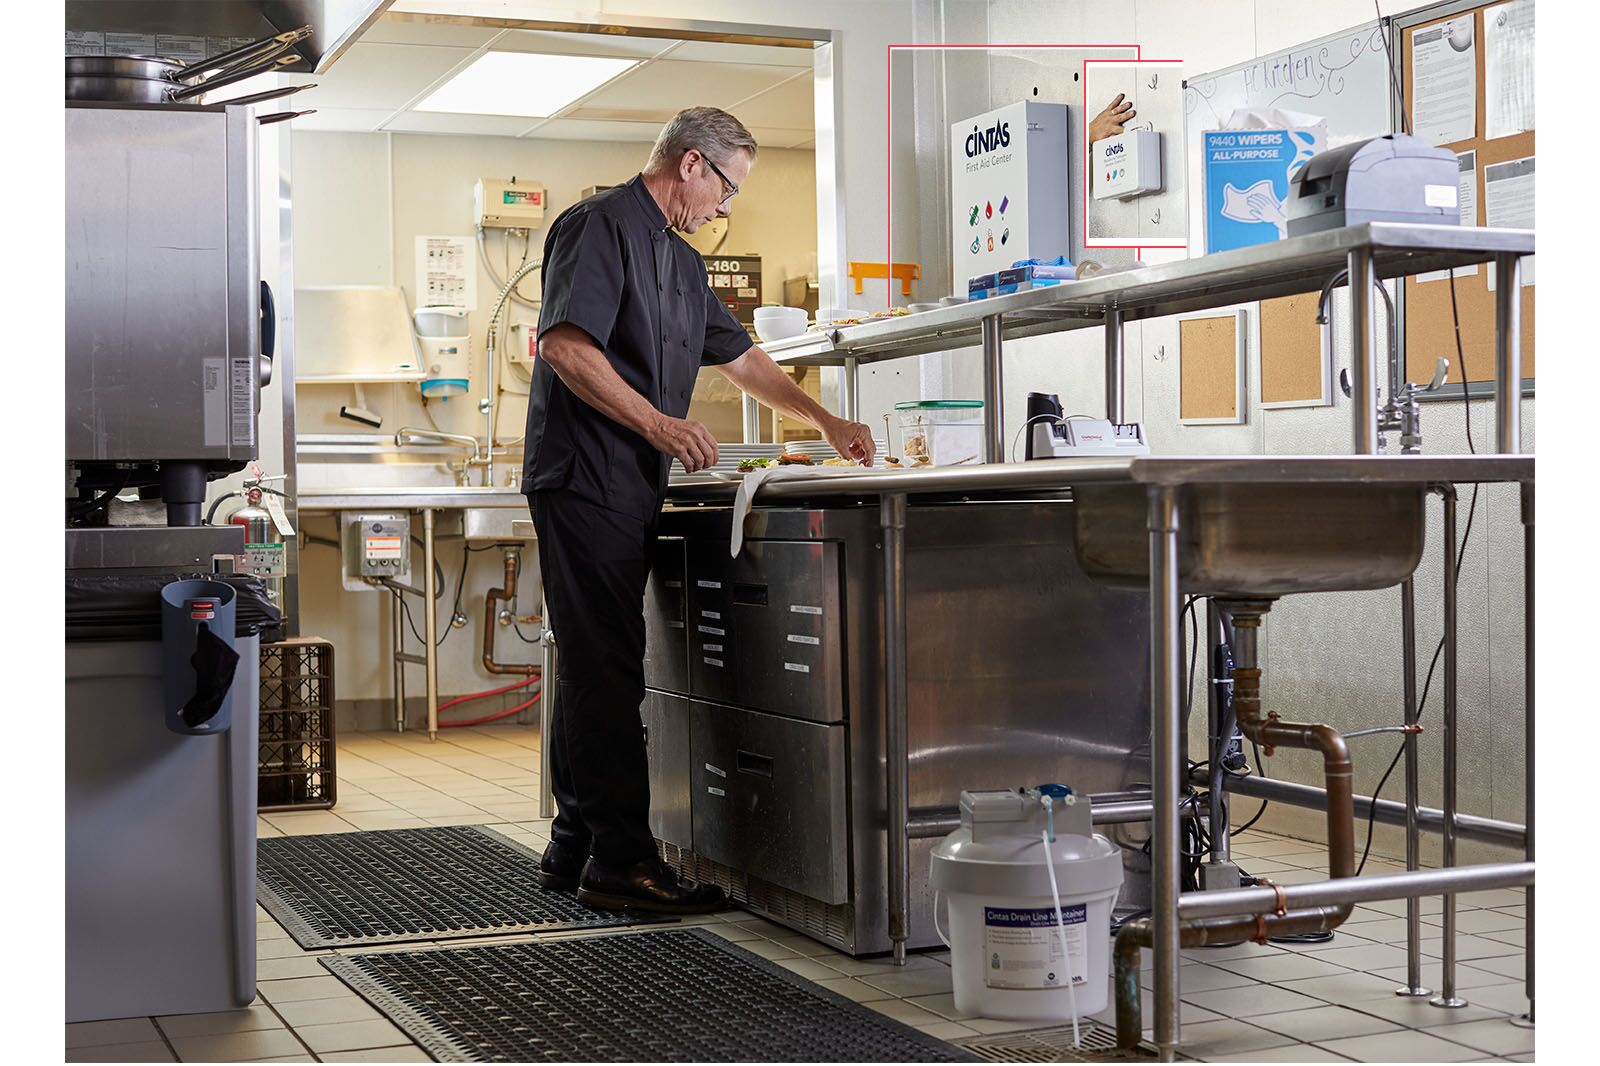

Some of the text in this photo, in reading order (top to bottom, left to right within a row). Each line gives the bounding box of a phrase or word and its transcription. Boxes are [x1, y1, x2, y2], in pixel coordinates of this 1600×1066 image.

[1209, 134, 1283, 147] 9440 WIPERS
[1212, 149, 1280, 161] ALL-PURPOSE
[966, 154, 1012, 173] First Aid Center
[987, 909, 1085, 922] Cintas Drain Line Mntainer
